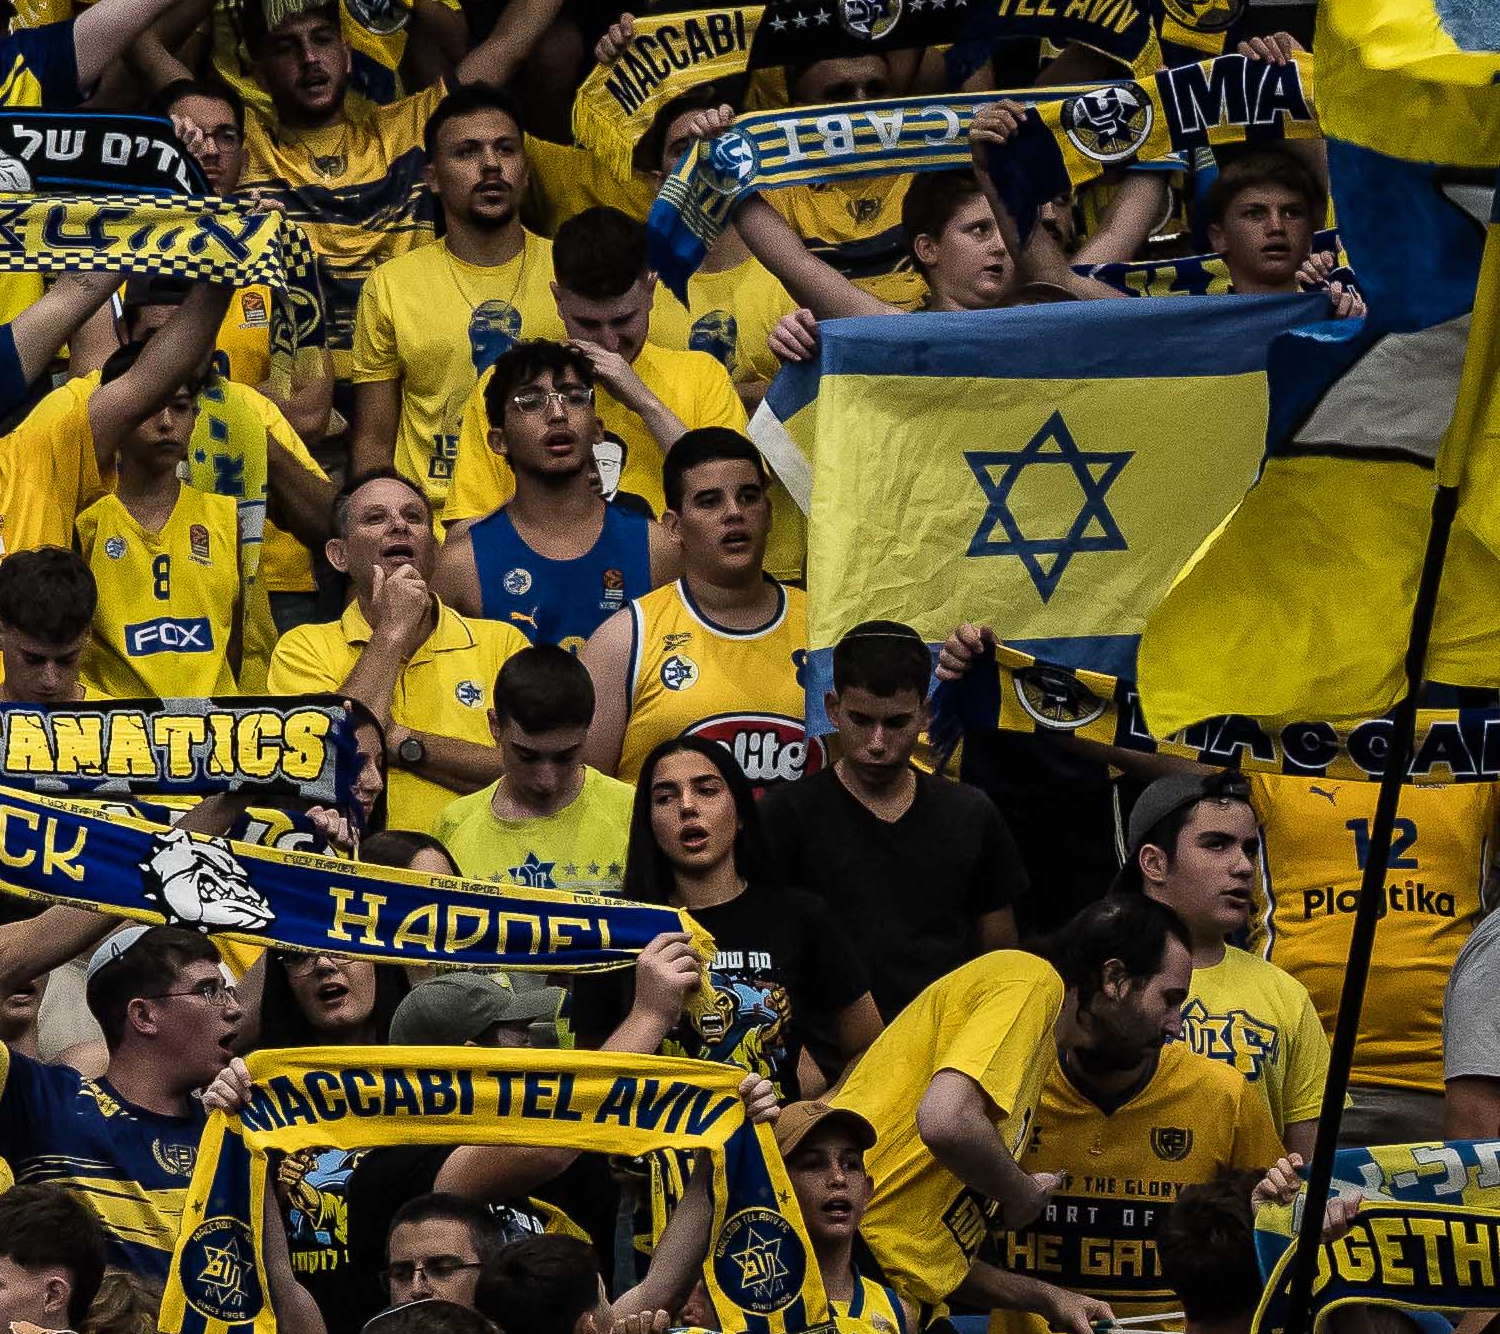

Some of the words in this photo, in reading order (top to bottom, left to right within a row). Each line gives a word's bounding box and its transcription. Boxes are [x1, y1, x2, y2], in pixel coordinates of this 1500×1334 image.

[605, 10, 746, 116] MACCABI
[12, 122, 84, 162] של
[152, 554, 171, 600] 8
[133, 622, 205, 651] FOX
[244, 1069, 475, 1128] MACCABI
[498, 1070, 593, 1122] TEL
[598, 1077, 742, 1138] AVIV
[1123, 1177, 1184, 1195] GLORY
[1045, 1205, 1099, 1226] ART
